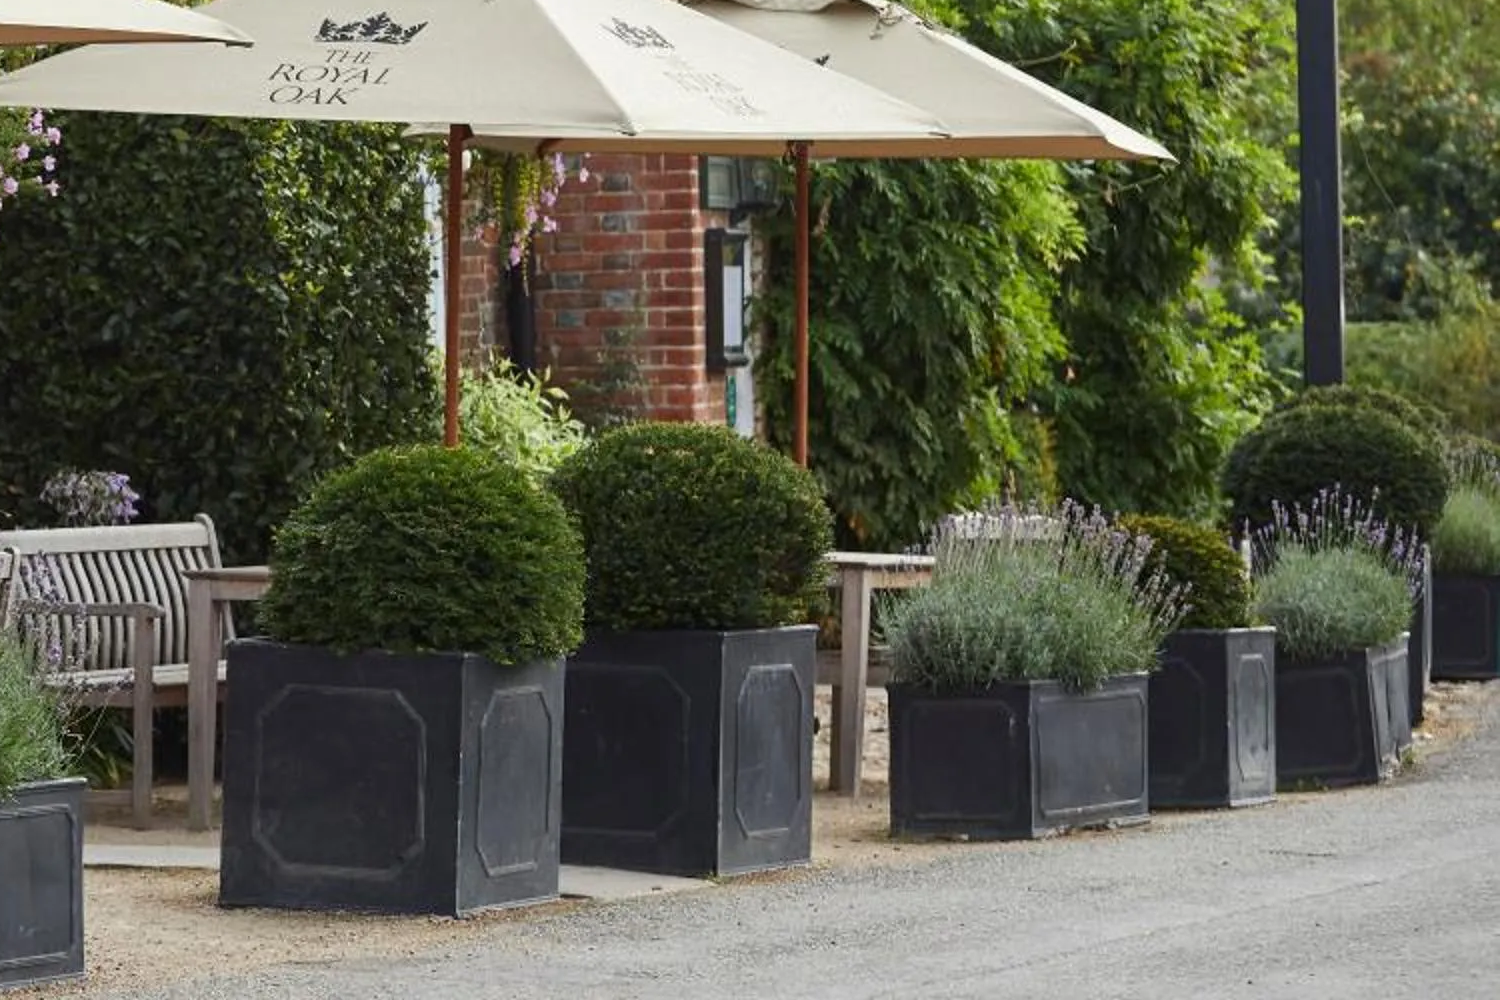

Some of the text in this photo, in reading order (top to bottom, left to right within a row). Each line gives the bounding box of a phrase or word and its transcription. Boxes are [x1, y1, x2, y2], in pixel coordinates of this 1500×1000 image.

[325, 48, 380, 64] THE
[268, 62, 393, 85] ROYAL
[268, 84, 360, 105] OAK
